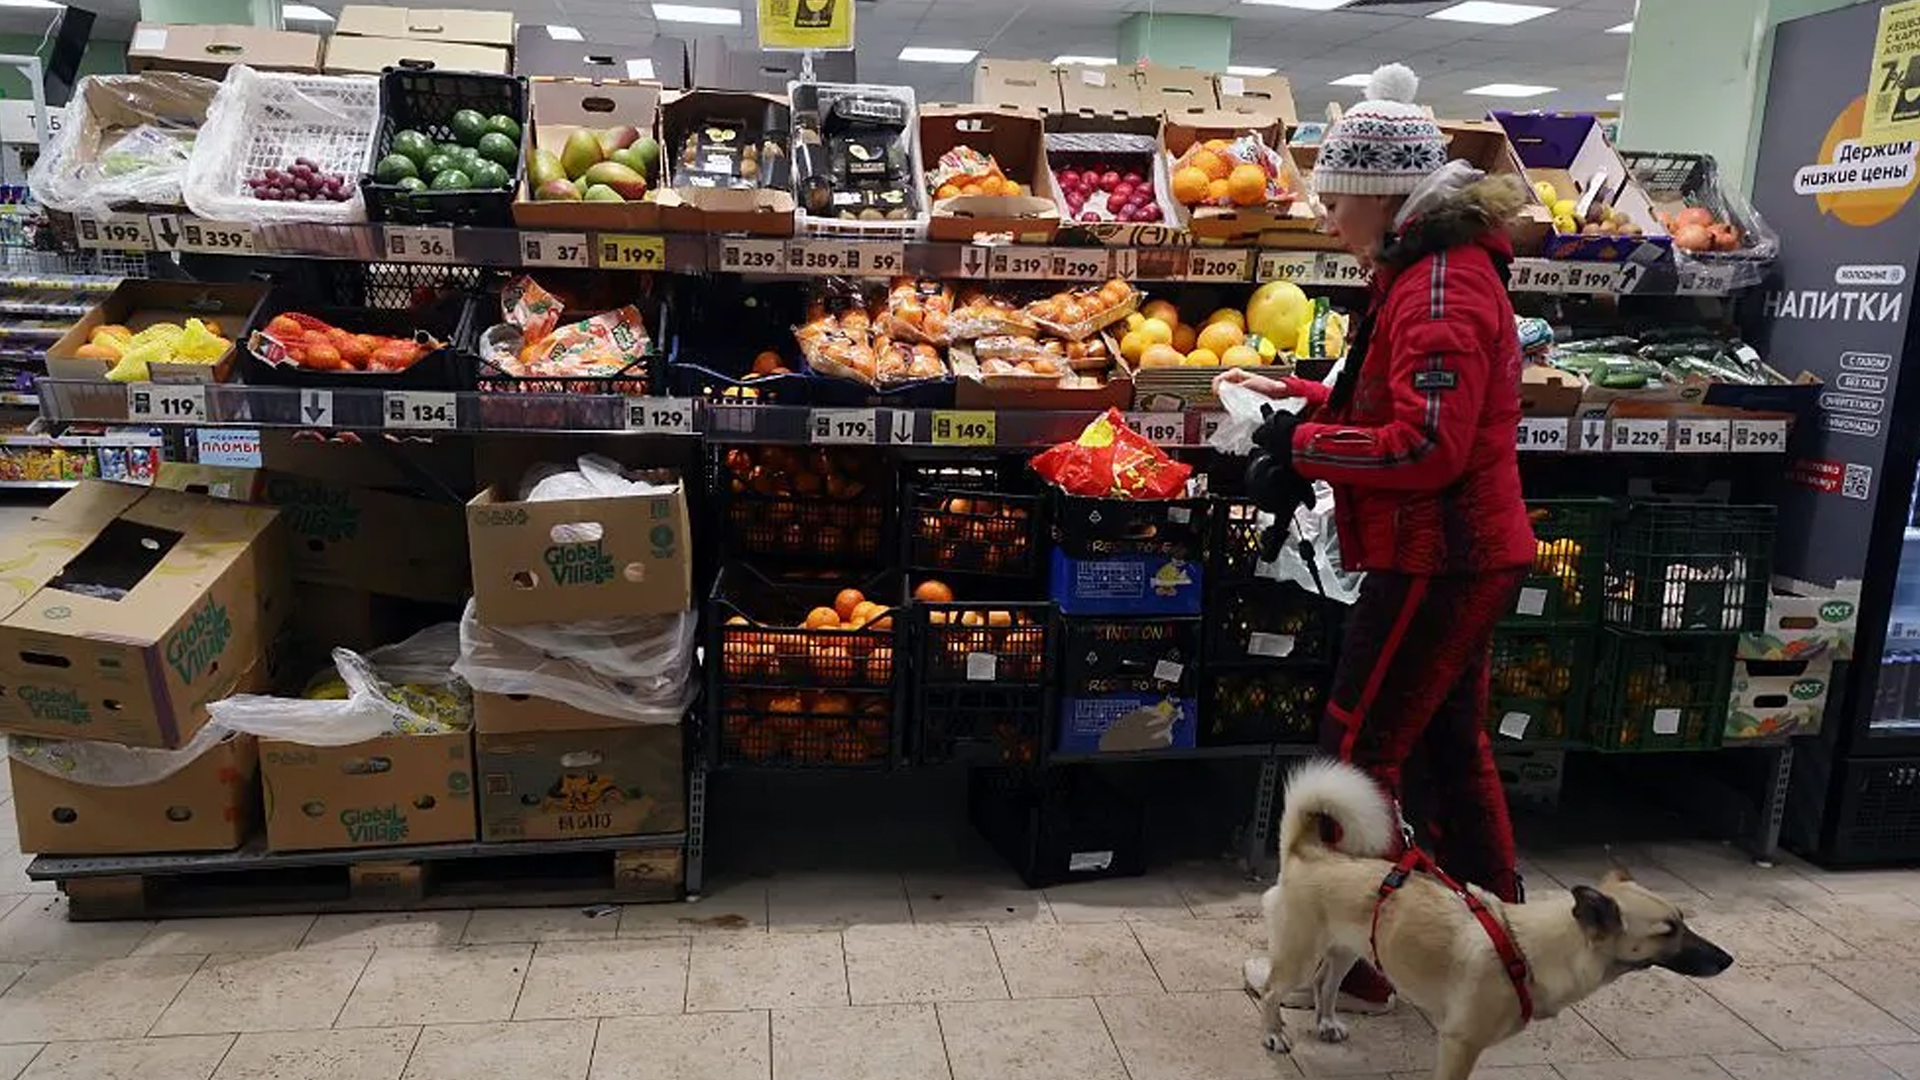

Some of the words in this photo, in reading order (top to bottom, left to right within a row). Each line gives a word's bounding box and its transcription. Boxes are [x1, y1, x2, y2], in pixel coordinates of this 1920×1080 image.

[1839, 141, 1912, 163] Держим
[1801, 169, 1857, 187] низкие
[1861, 164, 1908, 181] цены
[103, 225, 140, 241] 199
[205, 231, 243, 247] 339
[420, 240, 443, 255] 36
[557, 246, 579, 260] 37
[623, 248, 655, 263] 199
[742, 252, 775, 267] 239
[806, 253, 838, 268] 389
[873, 254, 895, 269] 59
[1012, 258, 1041, 272] 319
[1067, 262, 1098, 277] 299
[1206, 261, 1237, 276] 209
[1278, 264, 1305, 277] 199
[1533, 272, 1560, 286] 149
[1584, 272, 1610, 287] 199
[1763, 291, 1903, 323] НАПИТКИ
[161, 398, 195, 416] 119
[412, 405, 445, 421] 134
[651, 411, 683, 427] 129
[836, 422, 867, 437] 179
[956, 423, 986, 438] 149
[1145, 426, 1175, 440] 189
[1531, 430, 1560, 444] 109
[1631, 431, 1659, 445] 229
[1696, 431, 1721, 445] 154
[1750, 431, 1779, 445] 299
[544, 539, 603, 565] Global
[551, 561, 614, 587] Village
[167, 591, 218, 666] Global
[177, 617, 232, 685] Village
[17, 684, 78, 704] Global
[27, 700, 95, 724] Village
[340, 803, 397, 826] Global
[346, 821, 410, 842] Village
